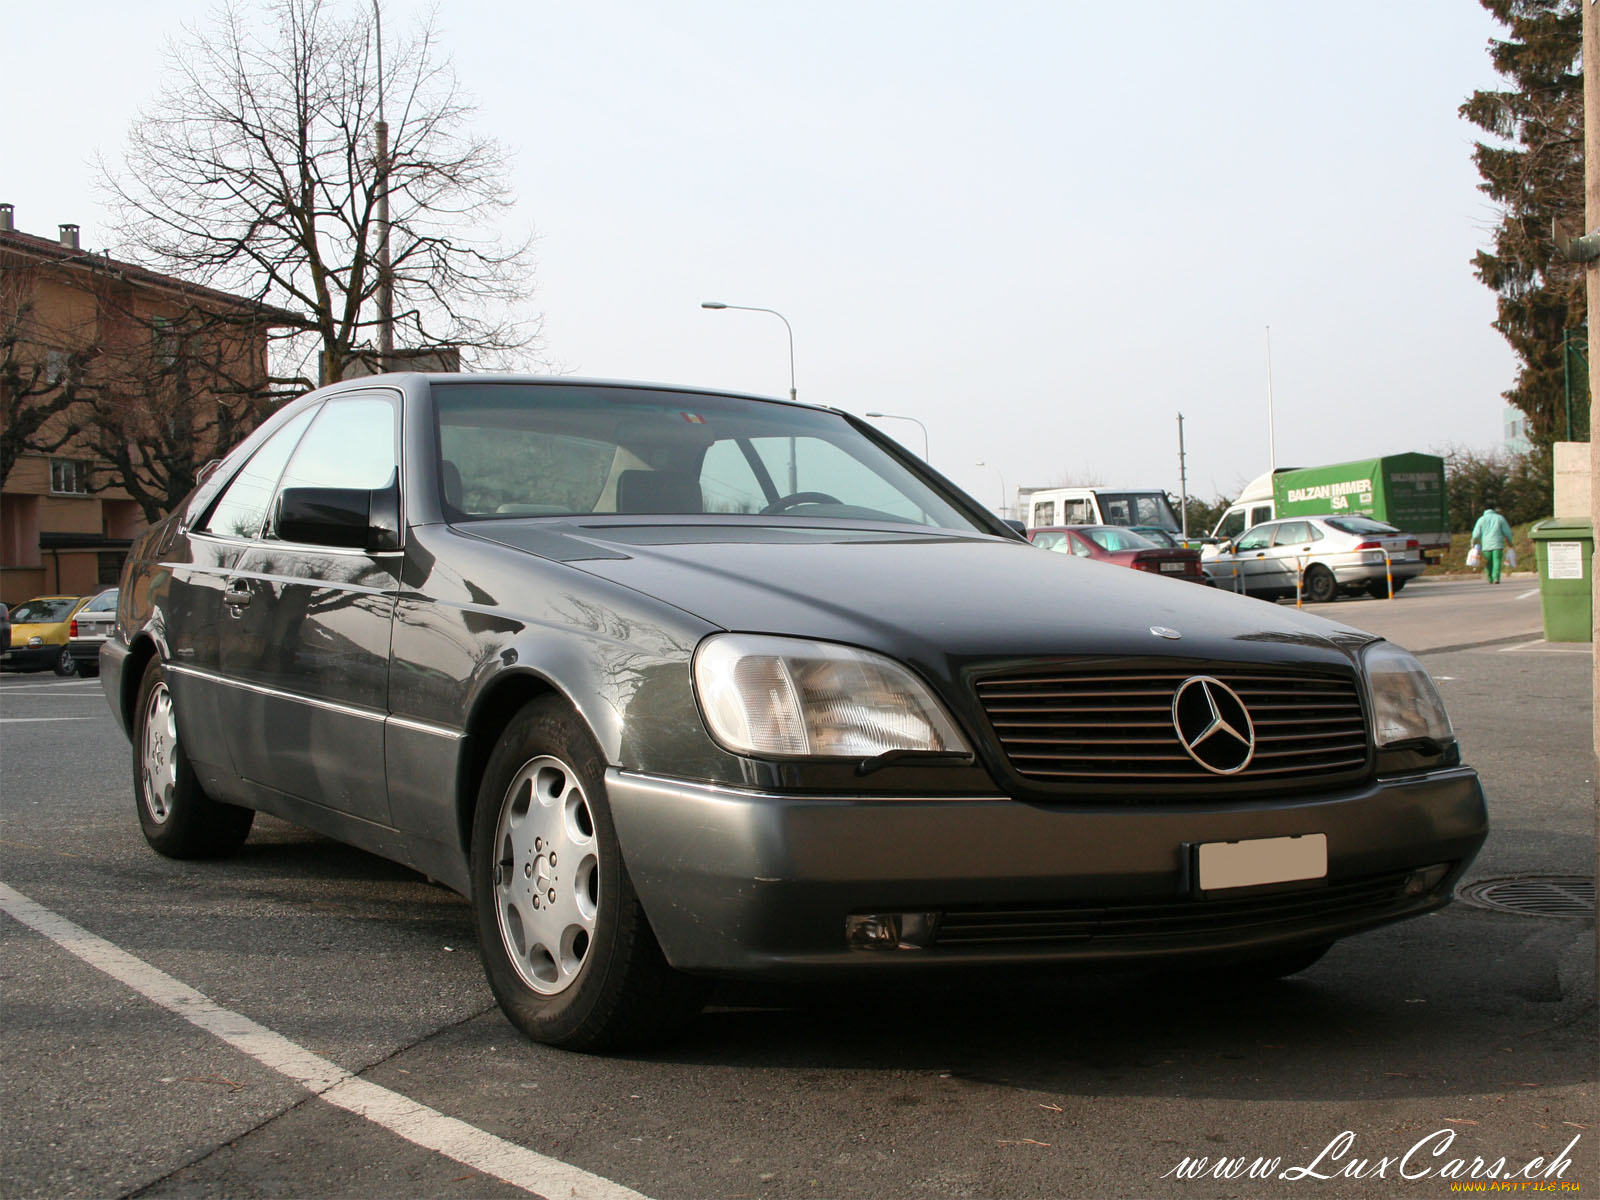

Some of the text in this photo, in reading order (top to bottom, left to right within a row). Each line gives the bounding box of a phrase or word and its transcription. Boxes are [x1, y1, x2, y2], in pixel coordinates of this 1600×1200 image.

[1288, 479, 1371, 503] BALZAN IMMER
[1332, 496, 1348, 509] SA
